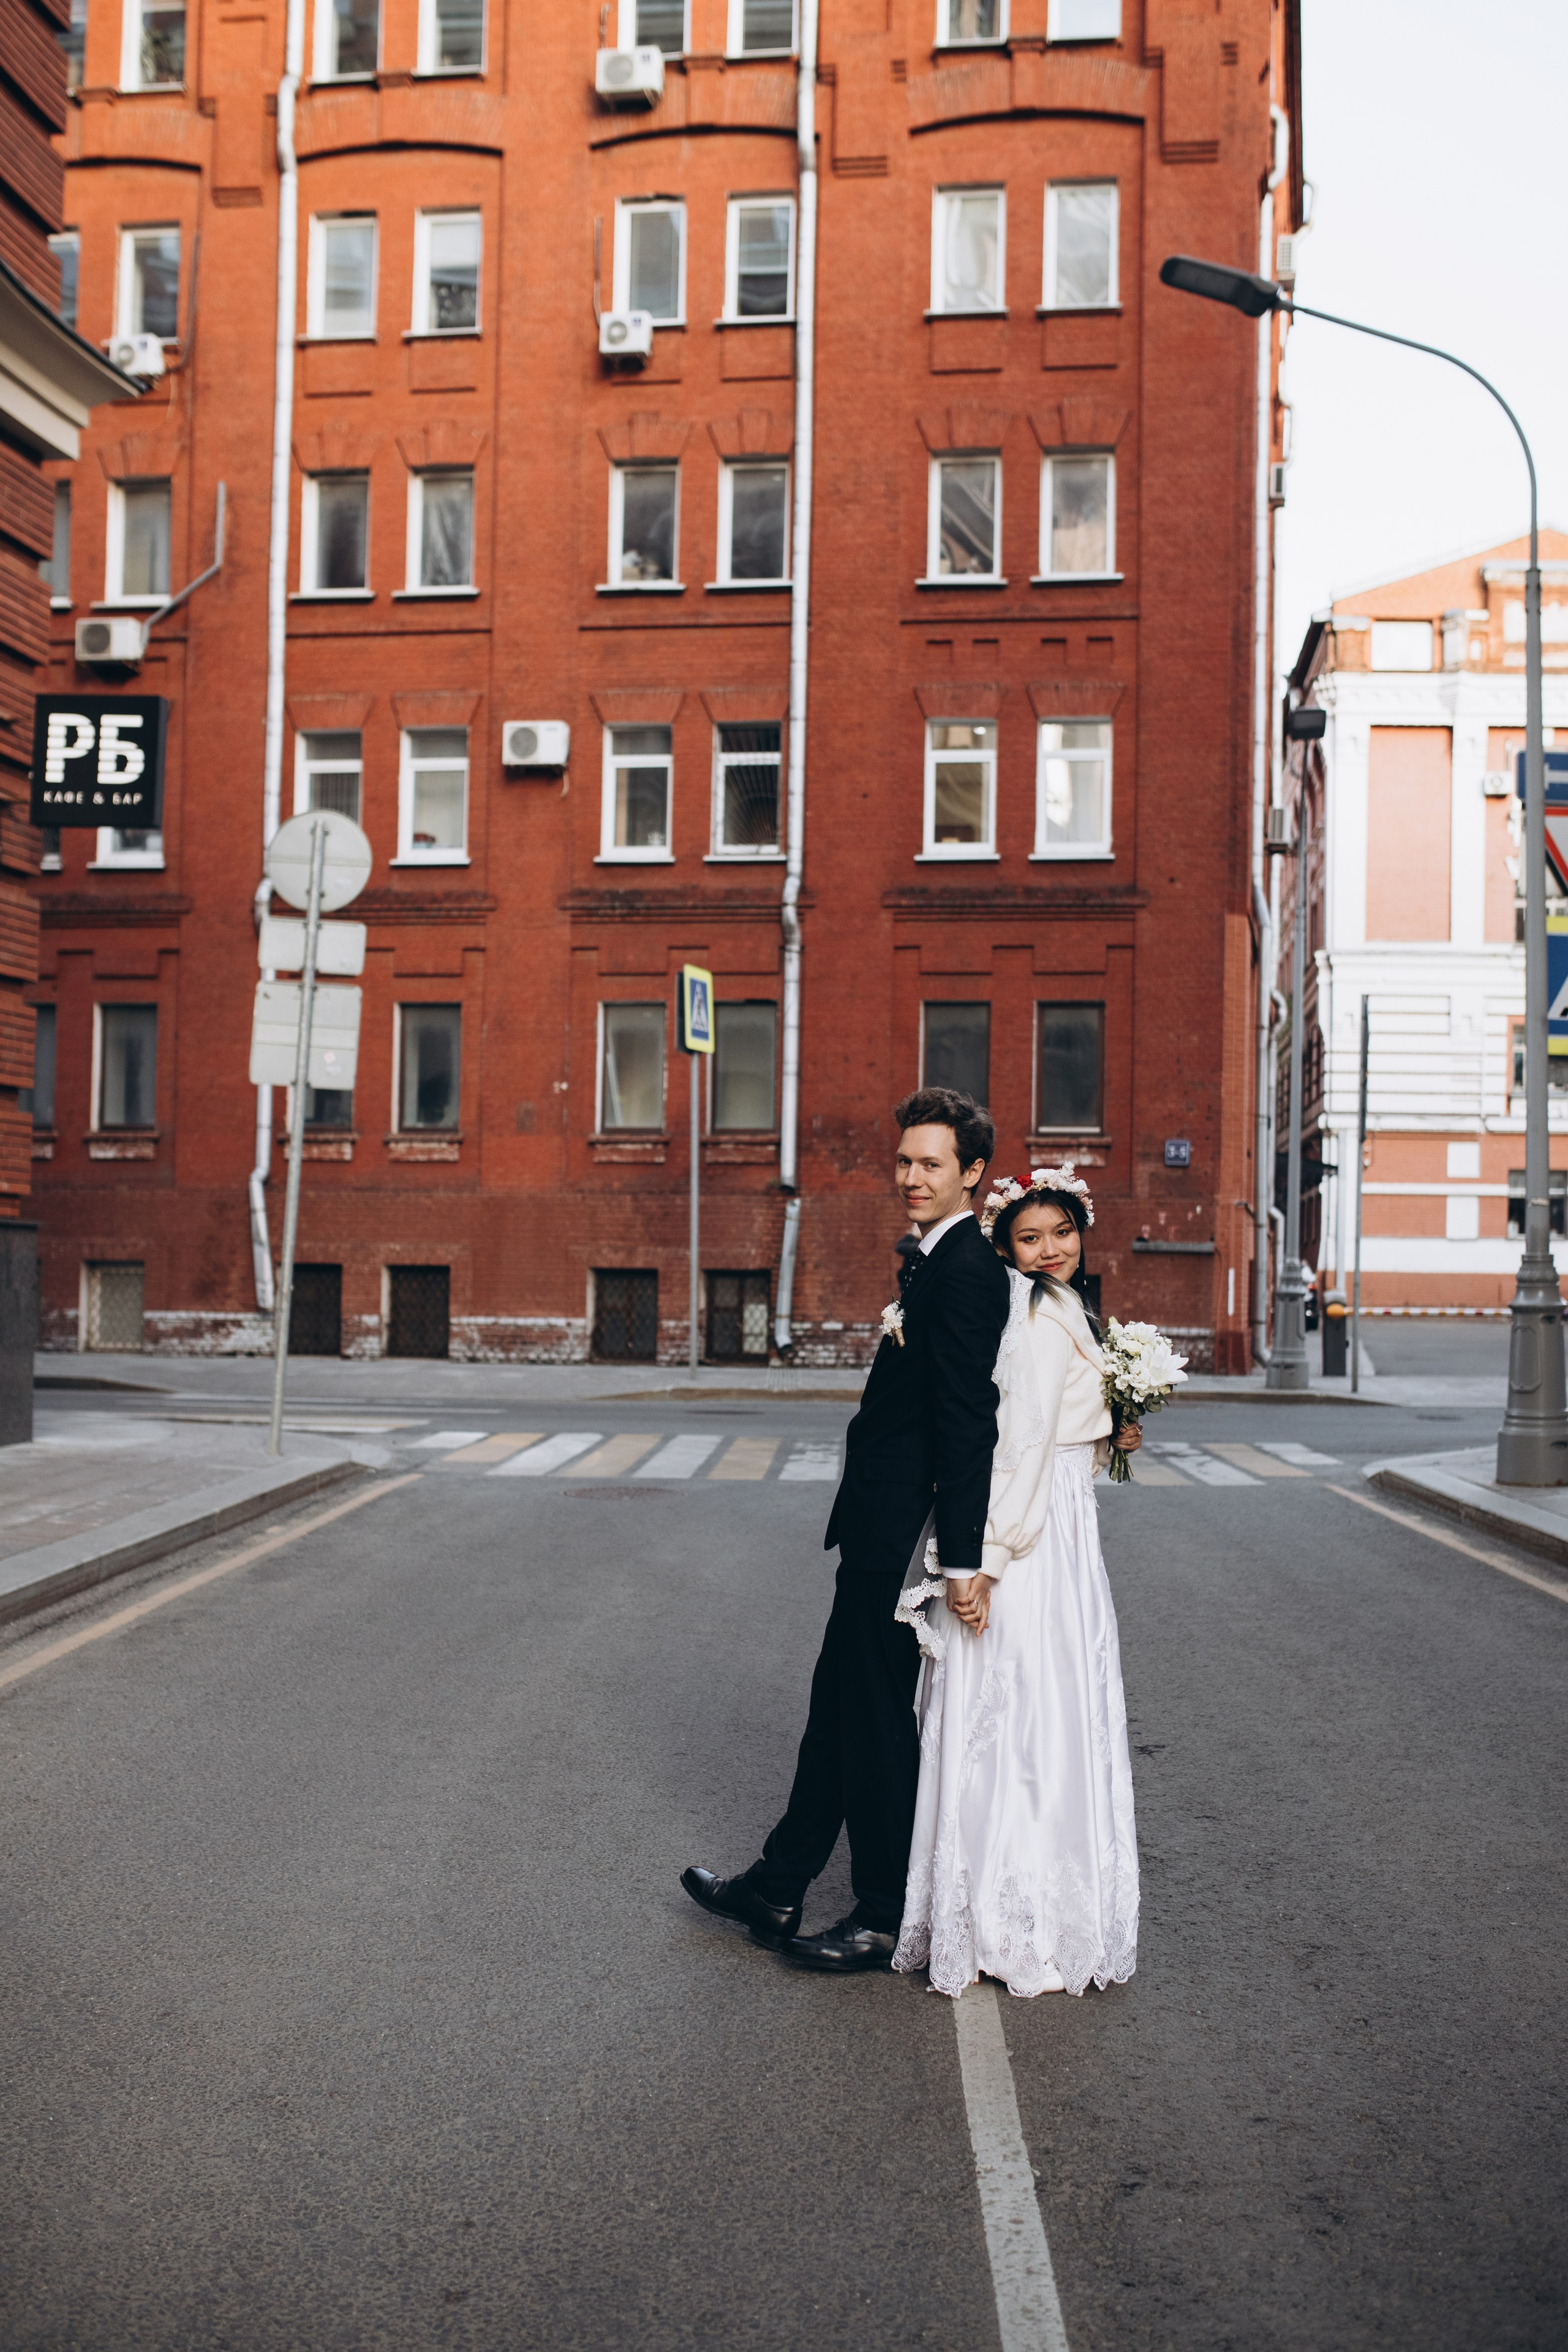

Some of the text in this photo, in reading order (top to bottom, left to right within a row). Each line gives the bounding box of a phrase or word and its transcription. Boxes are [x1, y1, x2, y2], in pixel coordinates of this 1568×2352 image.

[45, 712, 145, 785] РБ
[43, 790, 143, 805] КАФЕ & БАР
